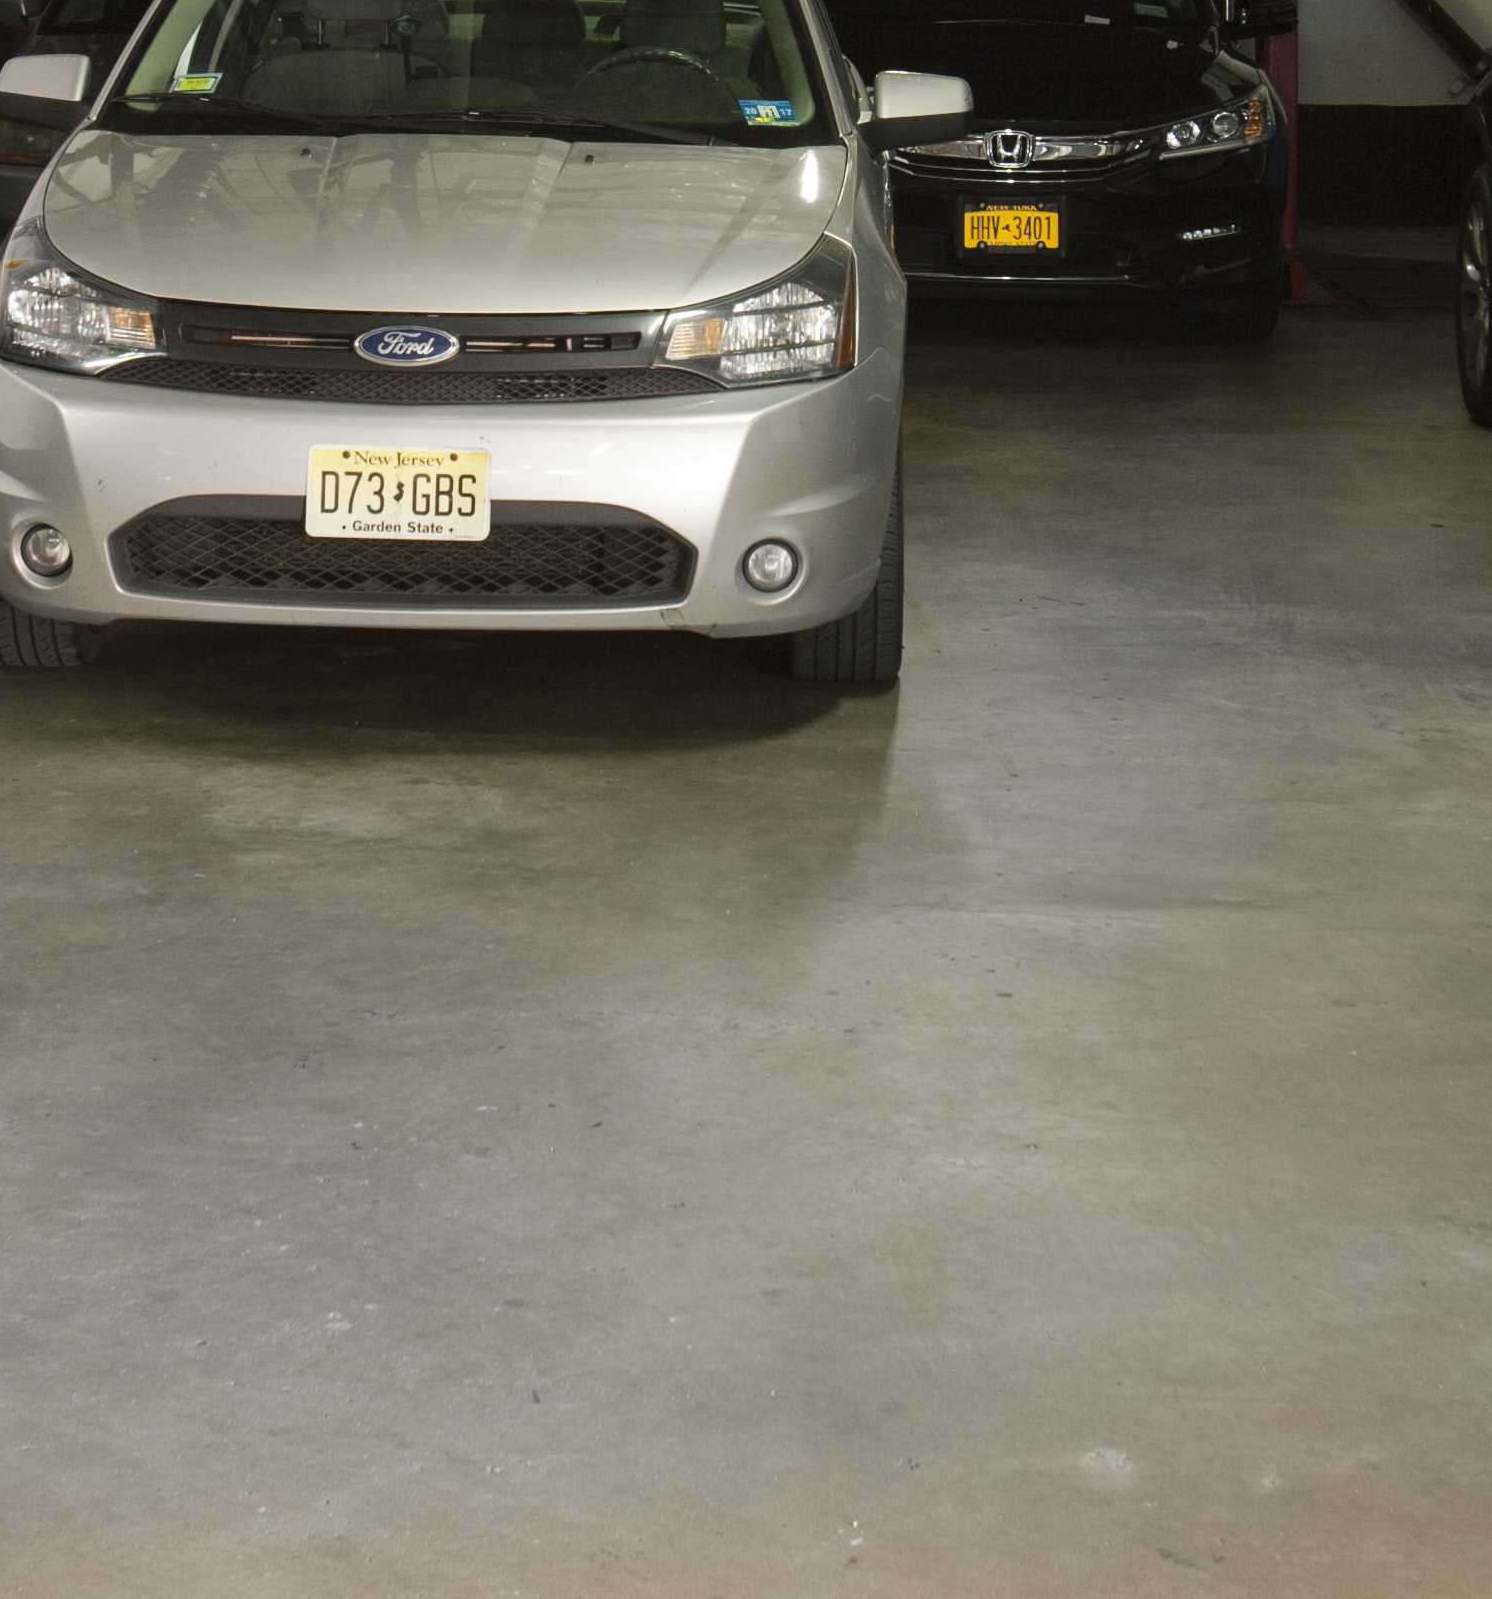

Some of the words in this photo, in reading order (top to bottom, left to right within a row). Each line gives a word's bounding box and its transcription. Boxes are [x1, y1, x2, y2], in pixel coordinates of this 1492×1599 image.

[1013, 216, 1051, 240] 3401
[377, 331, 435, 355] Ford
[353, 450, 393, 466] New
[394, 451, 445, 468] Jersey
[320, 470, 385, 515] D73
[412, 472, 477, 517] GBS
[352, 520, 402, 533] Garden
[407, 521, 444, 534] State
